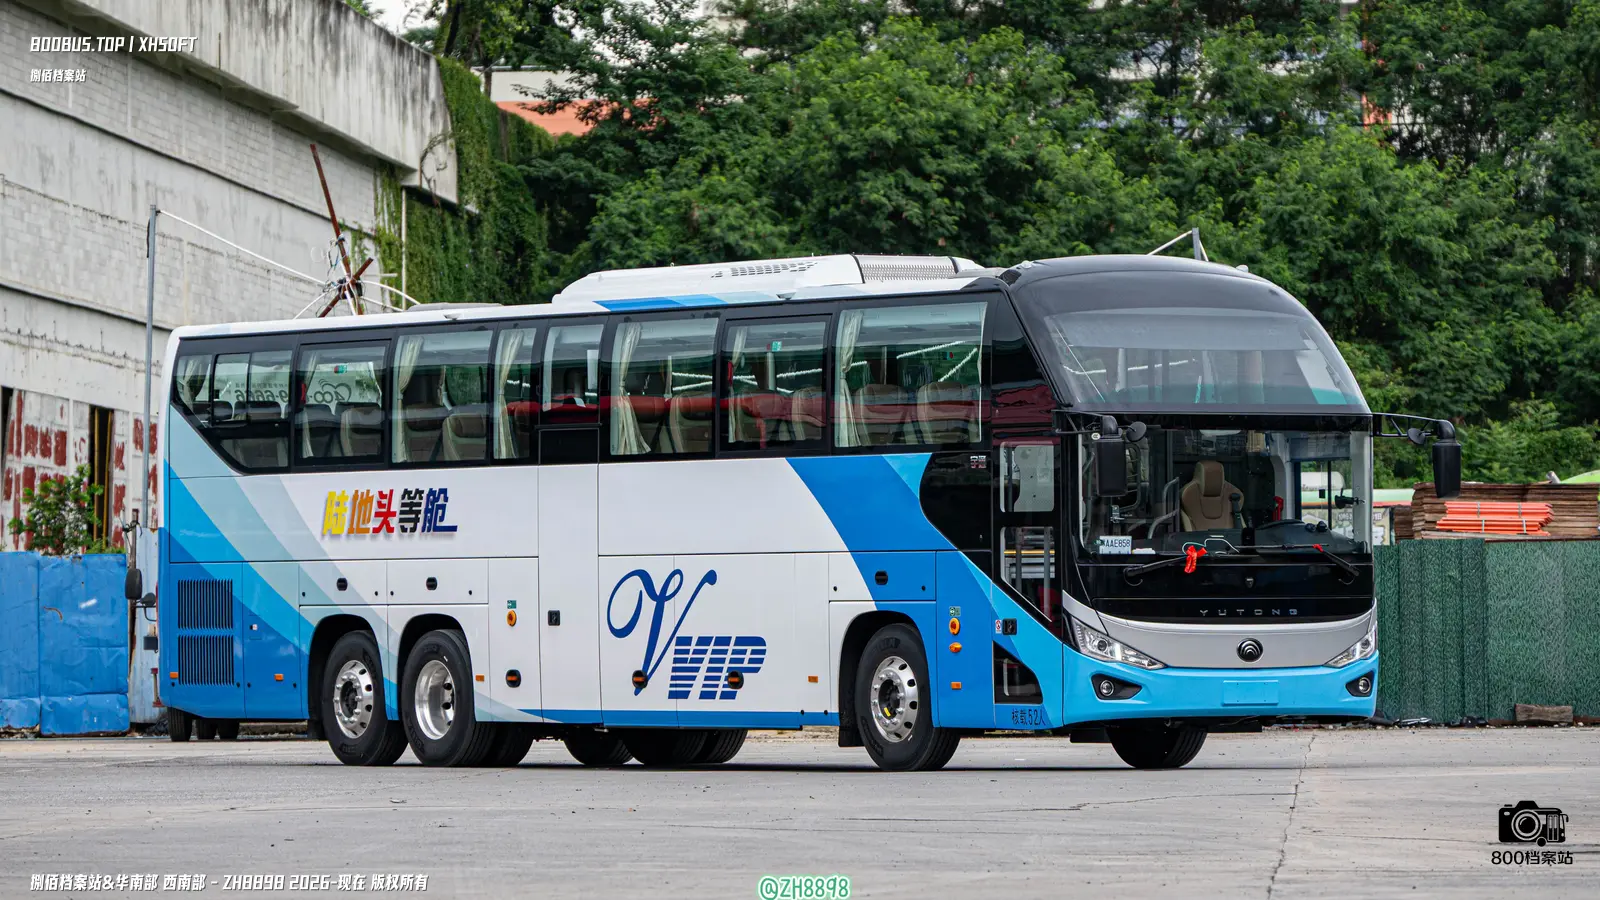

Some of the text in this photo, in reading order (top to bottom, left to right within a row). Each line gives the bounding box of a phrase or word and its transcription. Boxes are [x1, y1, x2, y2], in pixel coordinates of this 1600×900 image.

[322, 487, 458, 535] 陆地头等舱
[1199, 608, 1298, 616] YUTONG
[1011, 708, 1046, 726] 核载52人
